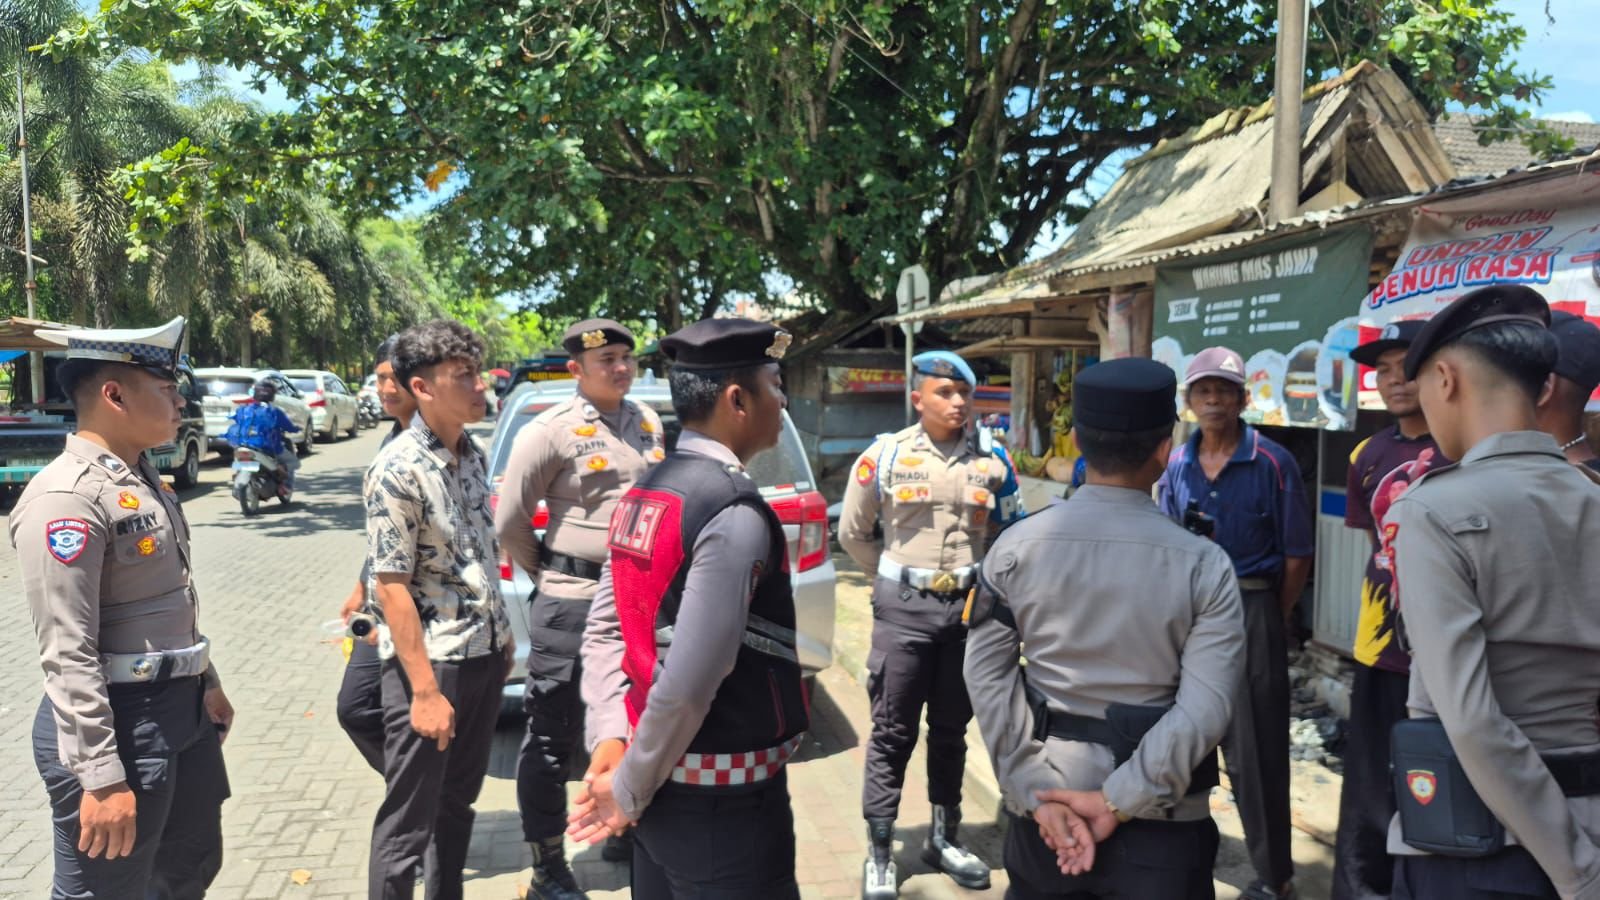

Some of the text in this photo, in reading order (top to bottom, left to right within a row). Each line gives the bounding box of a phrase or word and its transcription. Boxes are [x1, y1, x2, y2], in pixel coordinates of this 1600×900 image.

[1465, 207, 1557, 231] Good Day
[1405, 227, 1551, 267] UNDIAN
[1192, 246, 1318, 291] WARUNG MAS JAWA
[1369, 248, 1558, 308] PENUH RASA
